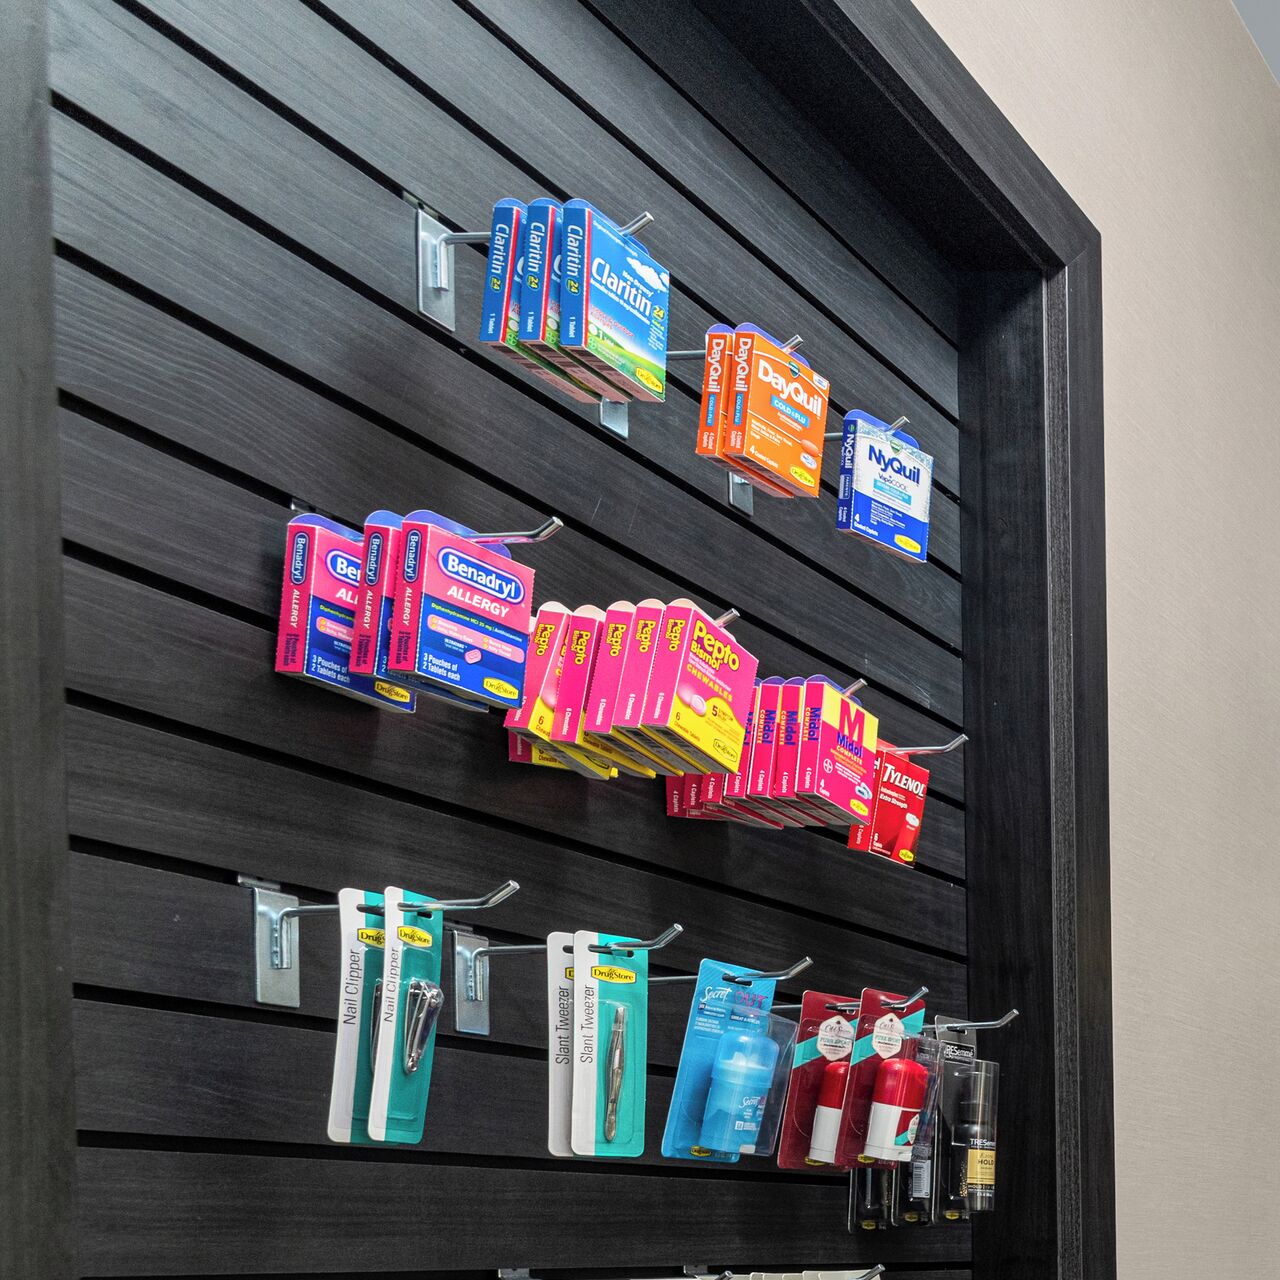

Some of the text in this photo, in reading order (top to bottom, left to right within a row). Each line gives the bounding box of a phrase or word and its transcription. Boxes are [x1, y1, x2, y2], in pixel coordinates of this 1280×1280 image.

[491, 223, 510, 274] Claritin
[592, 257, 652, 317] Claritin
[707, 338, 725, 393] DayQuil
[734, 337, 752, 392] DayQuil
[757, 359, 822, 417] DayQuil
[844, 433, 854, 470] NyQuil
[868, 445, 920, 485] NyQuil
[291, 537, 307, 581] Benadryl
[366, 537, 382, 582] Benadryl
[404, 534, 420, 579] Benadryl
[447, 554, 517, 600] Benadryl
[287, 589, 299, 629] ALLERGY
[362, 589, 374, 630] ALLERGY
[402, 586, 413, 627] ALLERGY
[446, 585, 510, 619] ALLERGY
[536, 623, 556, 657] Pepto
[312, 654, 349, 673] 3 Pouches of
[316, 664, 336, 679] Tablets
[686, 663, 733, 703] CHEWABLES
[376, 682, 410, 702] DrugStore
[711, 705, 718, 716] 5
[756, 709, 766, 744] COMPLETE
[762, 709, 776, 745] Midol
[839, 697, 865, 743] M
[836, 731, 864, 757] Midol
[883, 762, 926, 797] TYLENOL
[343, 949, 363, 1025] Nail Clipper
[384, 947, 400, 1023] Nail Clipper
[593, 968, 635, 984] DrugStore
[700, 986, 731, 1003] Secret
[556, 985, 570, 1065] Slant Tweezer
[580, 984, 594, 1063] Slant Tweezer
